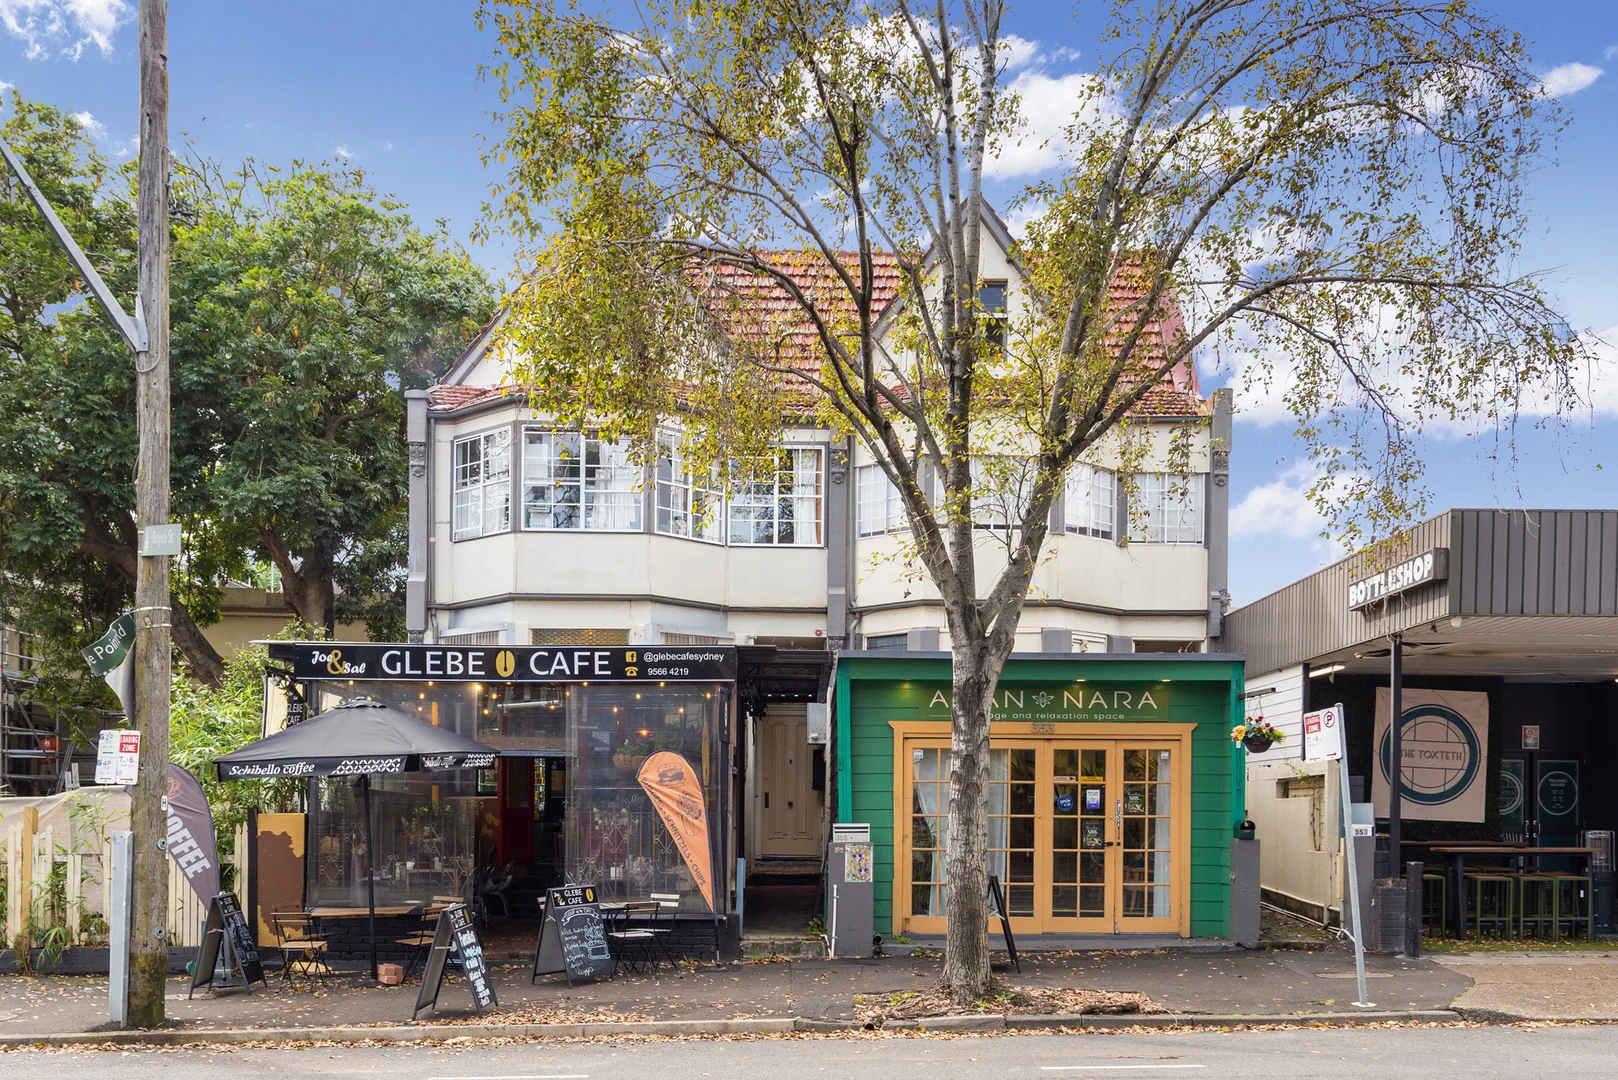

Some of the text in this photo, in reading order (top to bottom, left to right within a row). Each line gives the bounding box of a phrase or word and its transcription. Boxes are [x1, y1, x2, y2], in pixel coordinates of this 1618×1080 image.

[1349, 553, 1433, 607] BOTTLESHOP
[311, 651, 333, 665] Joe
[343, 662, 366, 674] Sal
[381, 650, 612, 676] GLEBE CAFE
[643, 651, 725, 663] @glebecafesydney
[647, 668, 689, 676] 9566 4219
[1063, 690, 1158, 709] NARA
[1093, 713, 1125, 721] space
[1032, 722, 1055, 733] 353
[121, 744, 136, 752] ZONE
[1400, 749, 1462, 761] THE TOXTETH
[228, 761, 316, 776] Schibello coffee
[1354, 828, 1369, 836] 353
[664, 814, 692, 859] SCHNITZELS
[691, 863, 707, 886] CHIPS
[564, 888, 583, 897] GLEBE
[567, 896, 583, 905] CAFE
